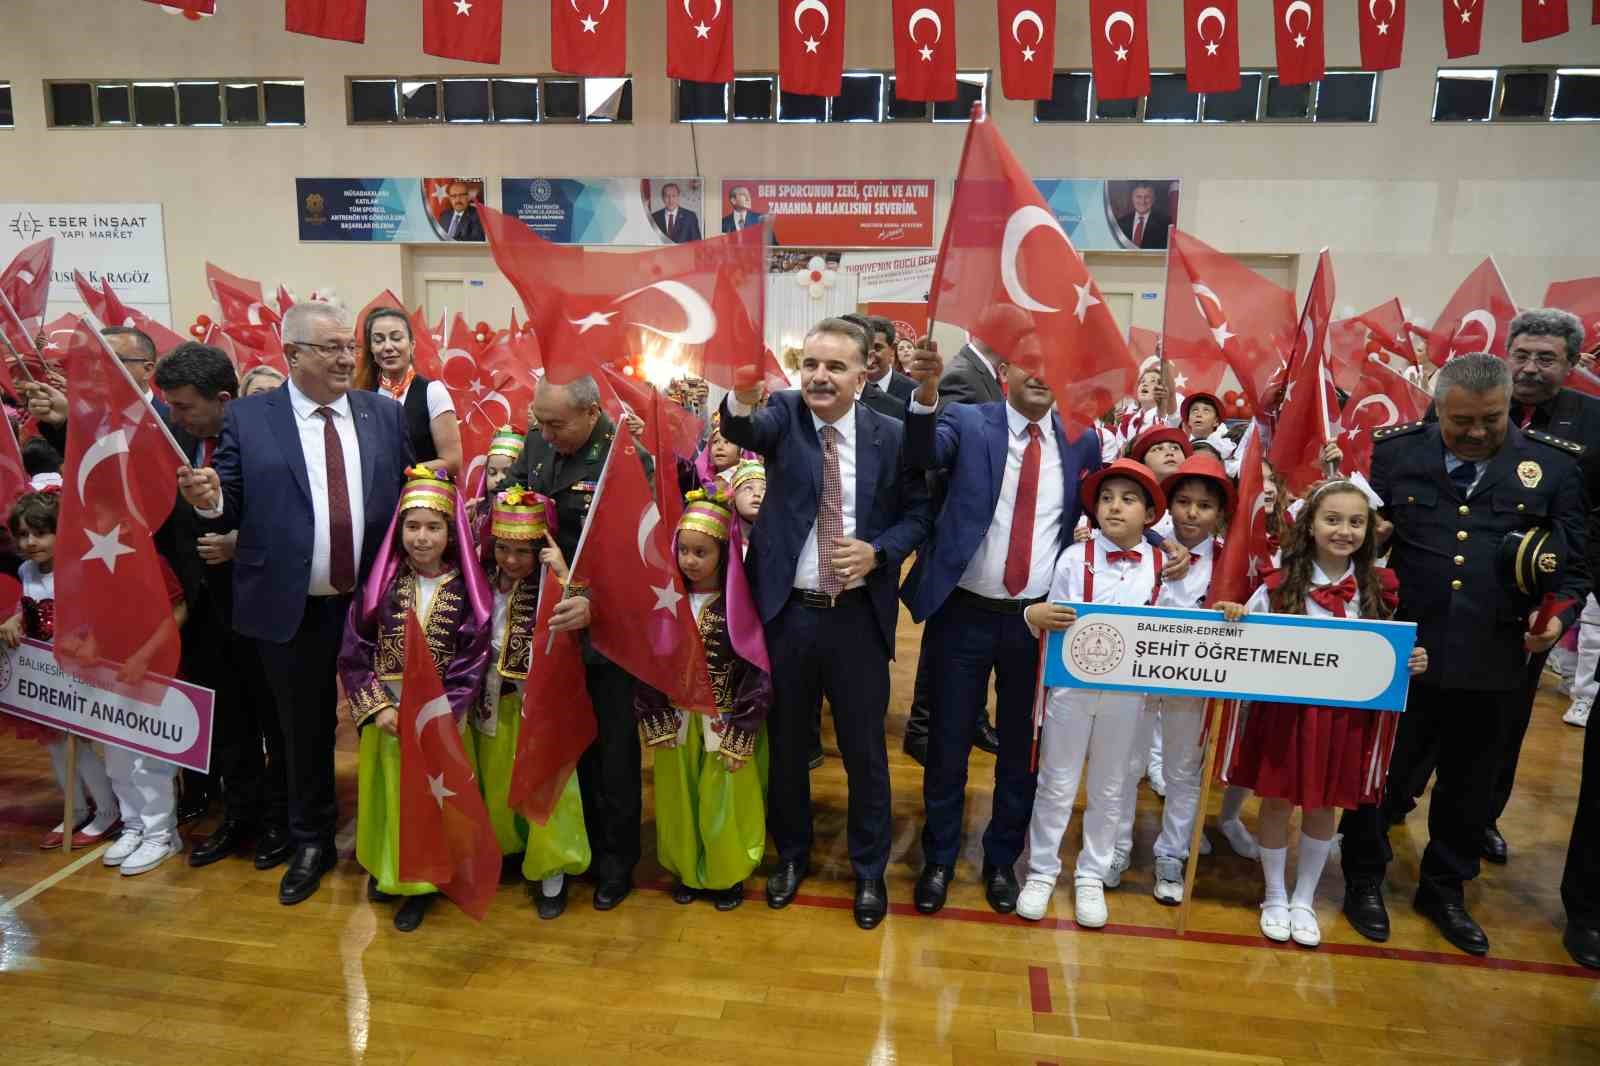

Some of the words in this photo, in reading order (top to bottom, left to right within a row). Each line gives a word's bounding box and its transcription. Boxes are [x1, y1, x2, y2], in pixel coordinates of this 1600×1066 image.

[758, 184, 778, 198] BEN
[779, 184, 834, 198] SPORCUNUN
[863, 181, 890, 201] ÇEVİK
[892, 184, 904, 198] VE
[905, 184, 929, 198] AYNI
[768, 201, 813, 216] ZAMANDA
[814, 201, 872, 216] AHLAKLISINI
[48, 216, 88, 228] ESER
[94, 213, 148, 231] İNŞAAT
[61, 230, 85, 239] YAPI
[89, 230, 134, 239] MARKET
[89, 268, 150, 283] KRAGÖZ
[1136, 622, 1245, 638] BALIKESİR-EDREMİT
[1135, 639, 1190, 658] ŞEHİT
[1195, 641, 1340, 668] ÖĞRETMENLER
[1132, 660, 1227, 683] İLKOKULU
[18, 678, 87, 714] EDREMİT
[90, 702, 184, 743] ANAOKULU
